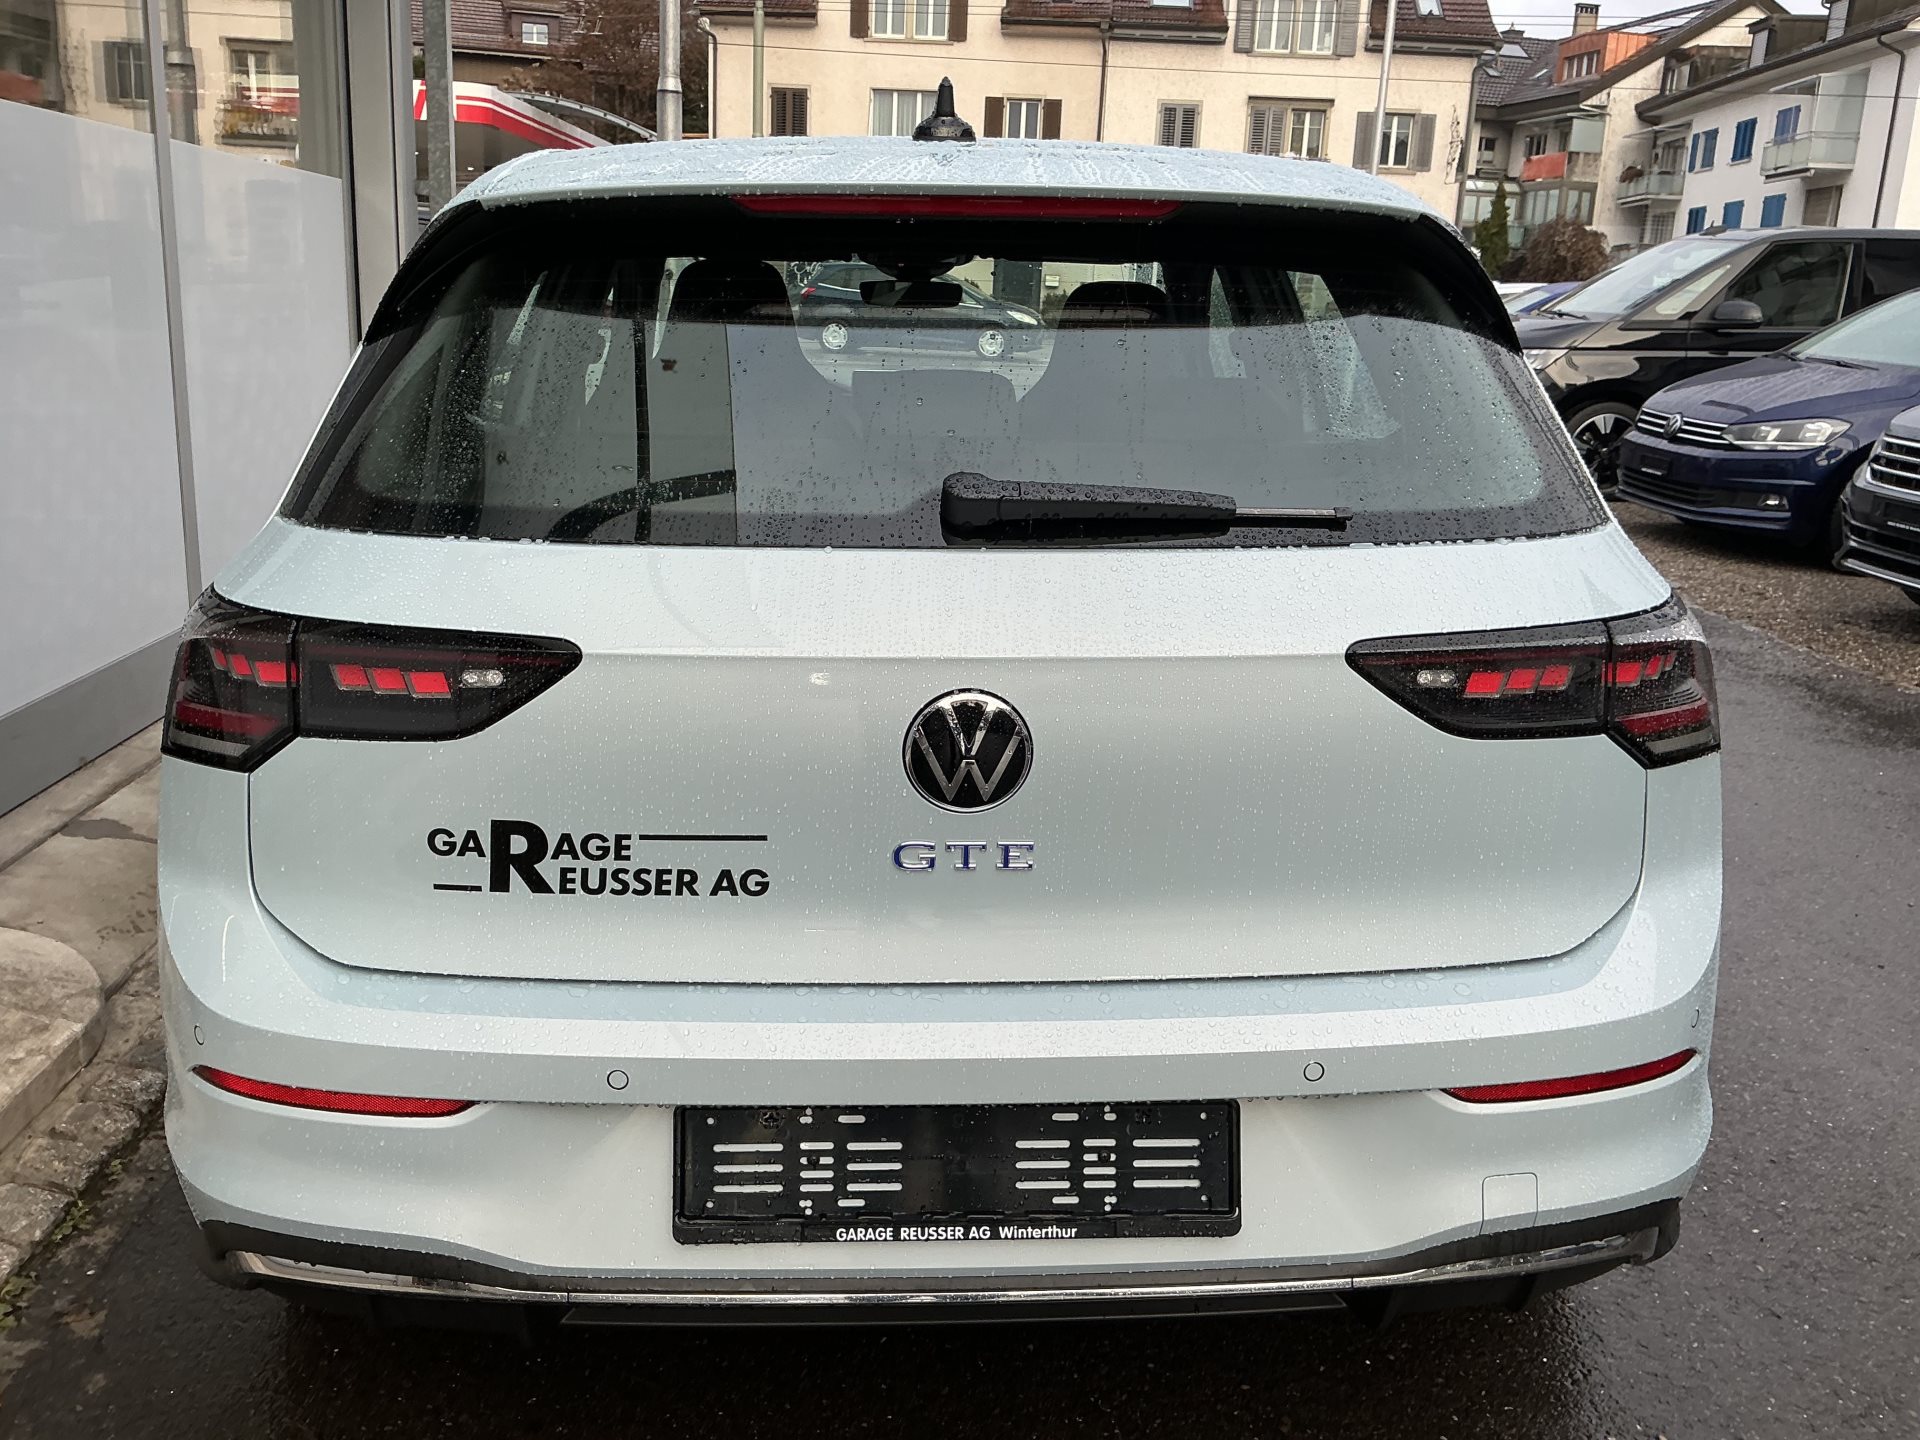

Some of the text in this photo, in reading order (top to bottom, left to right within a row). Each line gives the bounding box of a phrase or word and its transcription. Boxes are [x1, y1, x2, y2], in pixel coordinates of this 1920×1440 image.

[426, 818, 632, 894] GARAGE
[892, 840, 1035, 871] GTE
[709, 868, 770, 896] AG
[836, 1225, 1078, 1241] GARAGE REUSSER AG Winterthur
